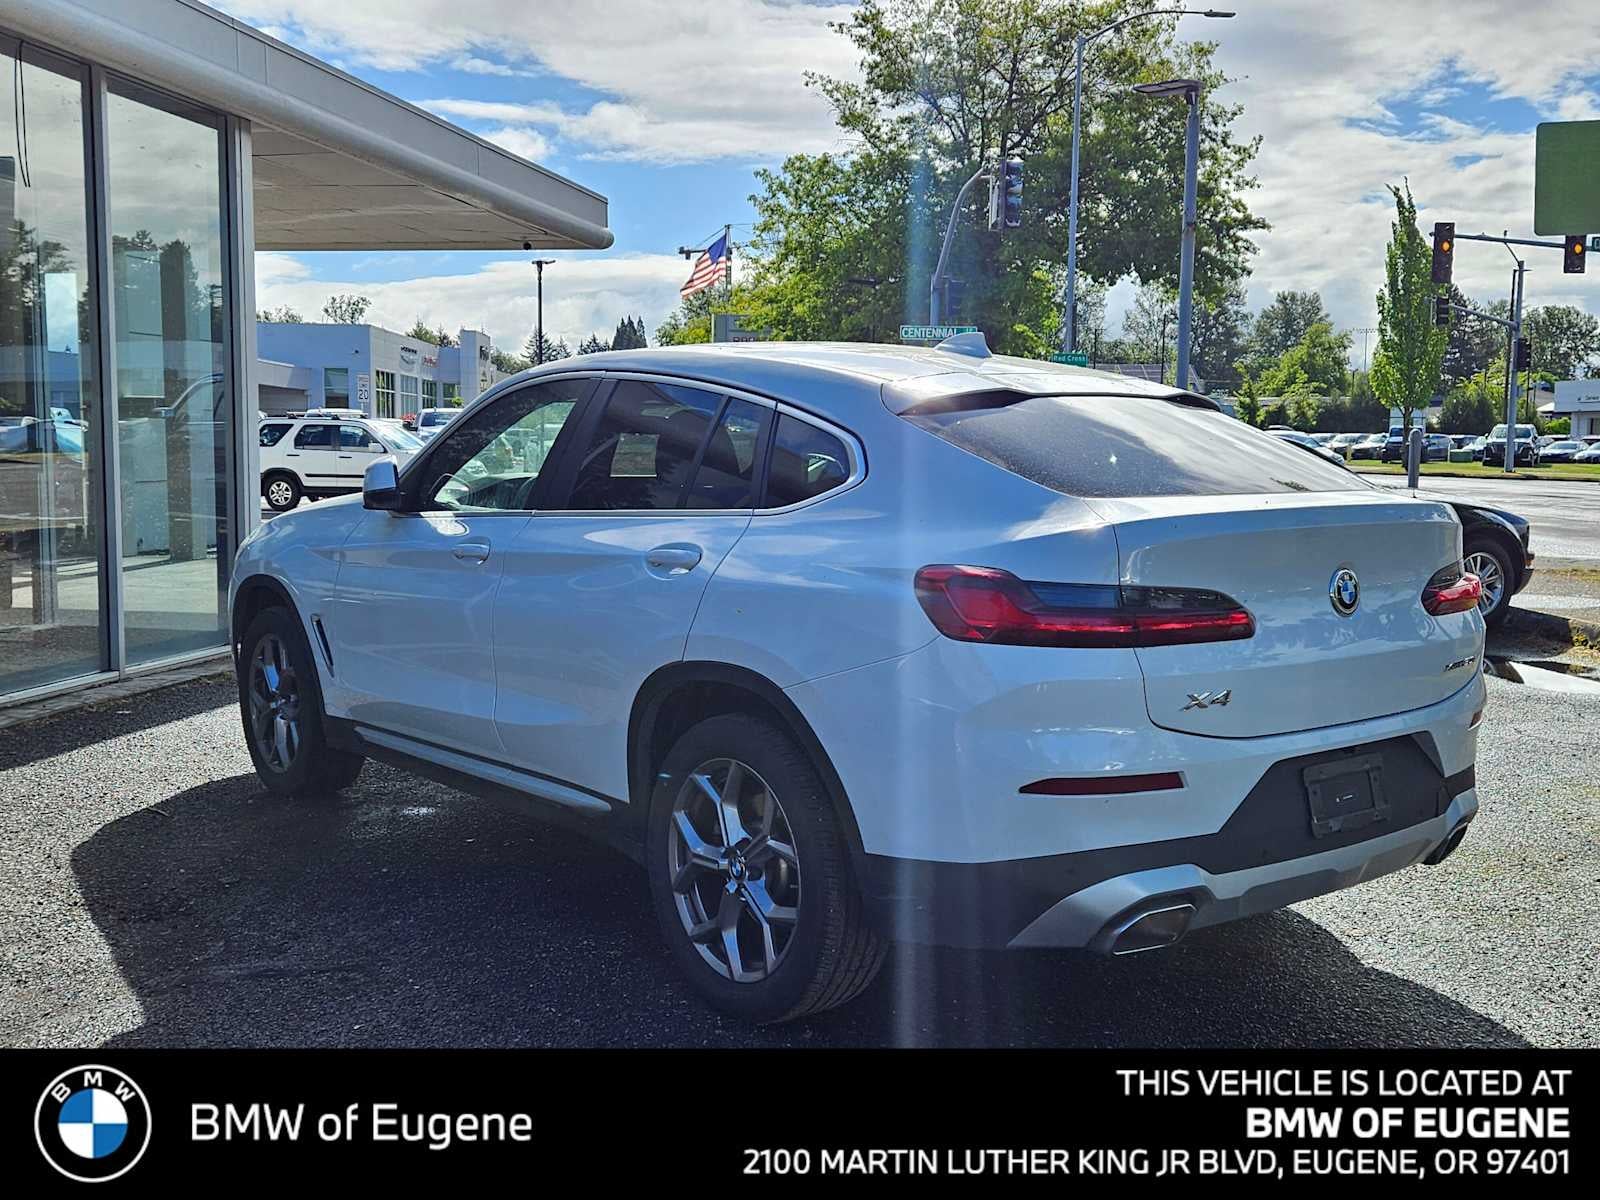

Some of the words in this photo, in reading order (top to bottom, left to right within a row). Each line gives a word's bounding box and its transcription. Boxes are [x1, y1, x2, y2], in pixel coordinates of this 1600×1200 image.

[901, 327, 957, 338] CENTENNIAL
[359, 389, 369, 400] 20
[1181, 690, 1232, 711] X4
